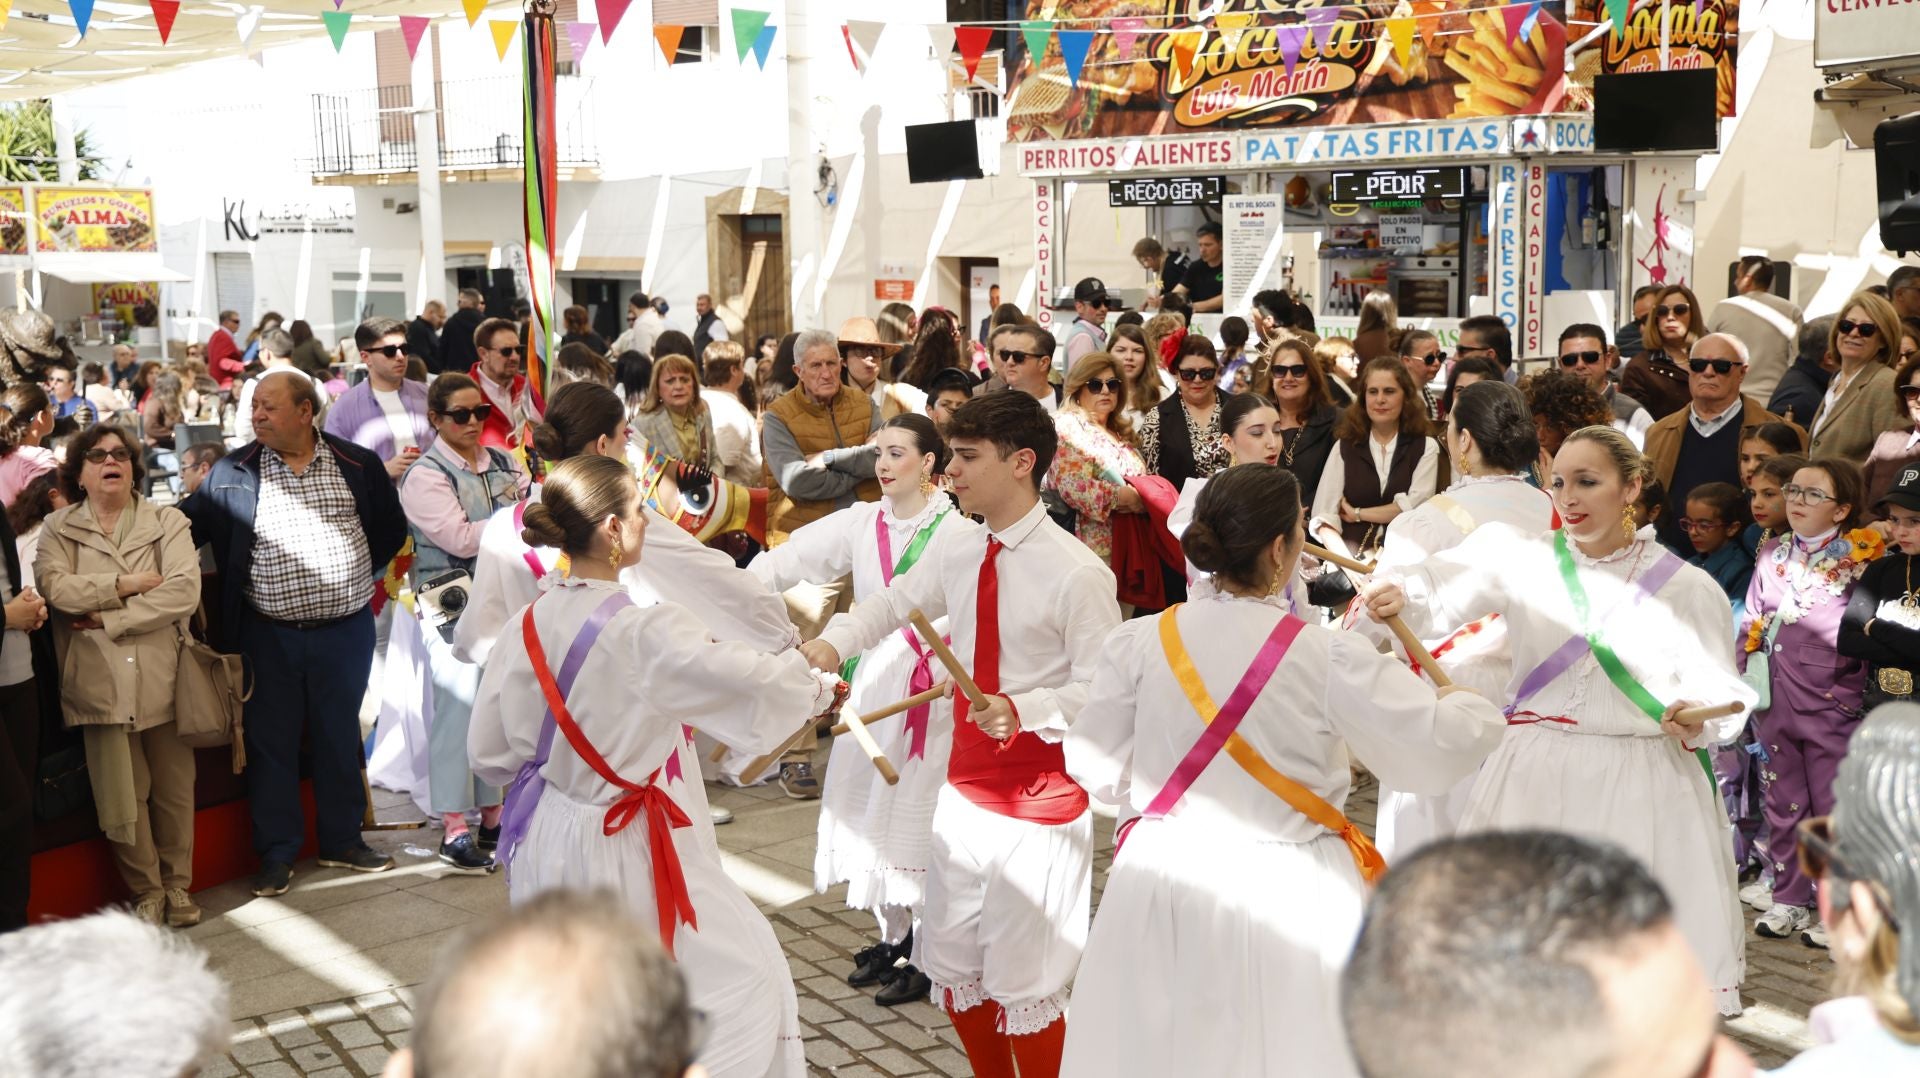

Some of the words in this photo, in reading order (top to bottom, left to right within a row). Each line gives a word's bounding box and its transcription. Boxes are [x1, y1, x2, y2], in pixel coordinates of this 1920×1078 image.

[1189, 79, 1241, 117] Luis
[1249, 57, 1330, 102] Marín
[1245, 131, 1379, 161] PATATAS
[1388, 124, 1499, 154] FRITAS
[1025, 145, 1116, 169] PERRITOS
[1121, 140, 1232, 165] CALIENTES
[1124, 183, 1204, 201] RECOGER
[1366, 175, 1426, 195] PEDIR
[66, 209, 128, 225] ALMA
[1380, 217, 1399, 225] SOLO
[1400, 216, 1421, 225] PAGOS
[1395, 226, 1407, 234] EN
[1381, 235, 1421, 245] EFECTIVO
[1528, 165, 1542, 350] BOCADILLOS
[111, 287, 145, 305] ALMA
[1899, 469, 1919, 487] P
